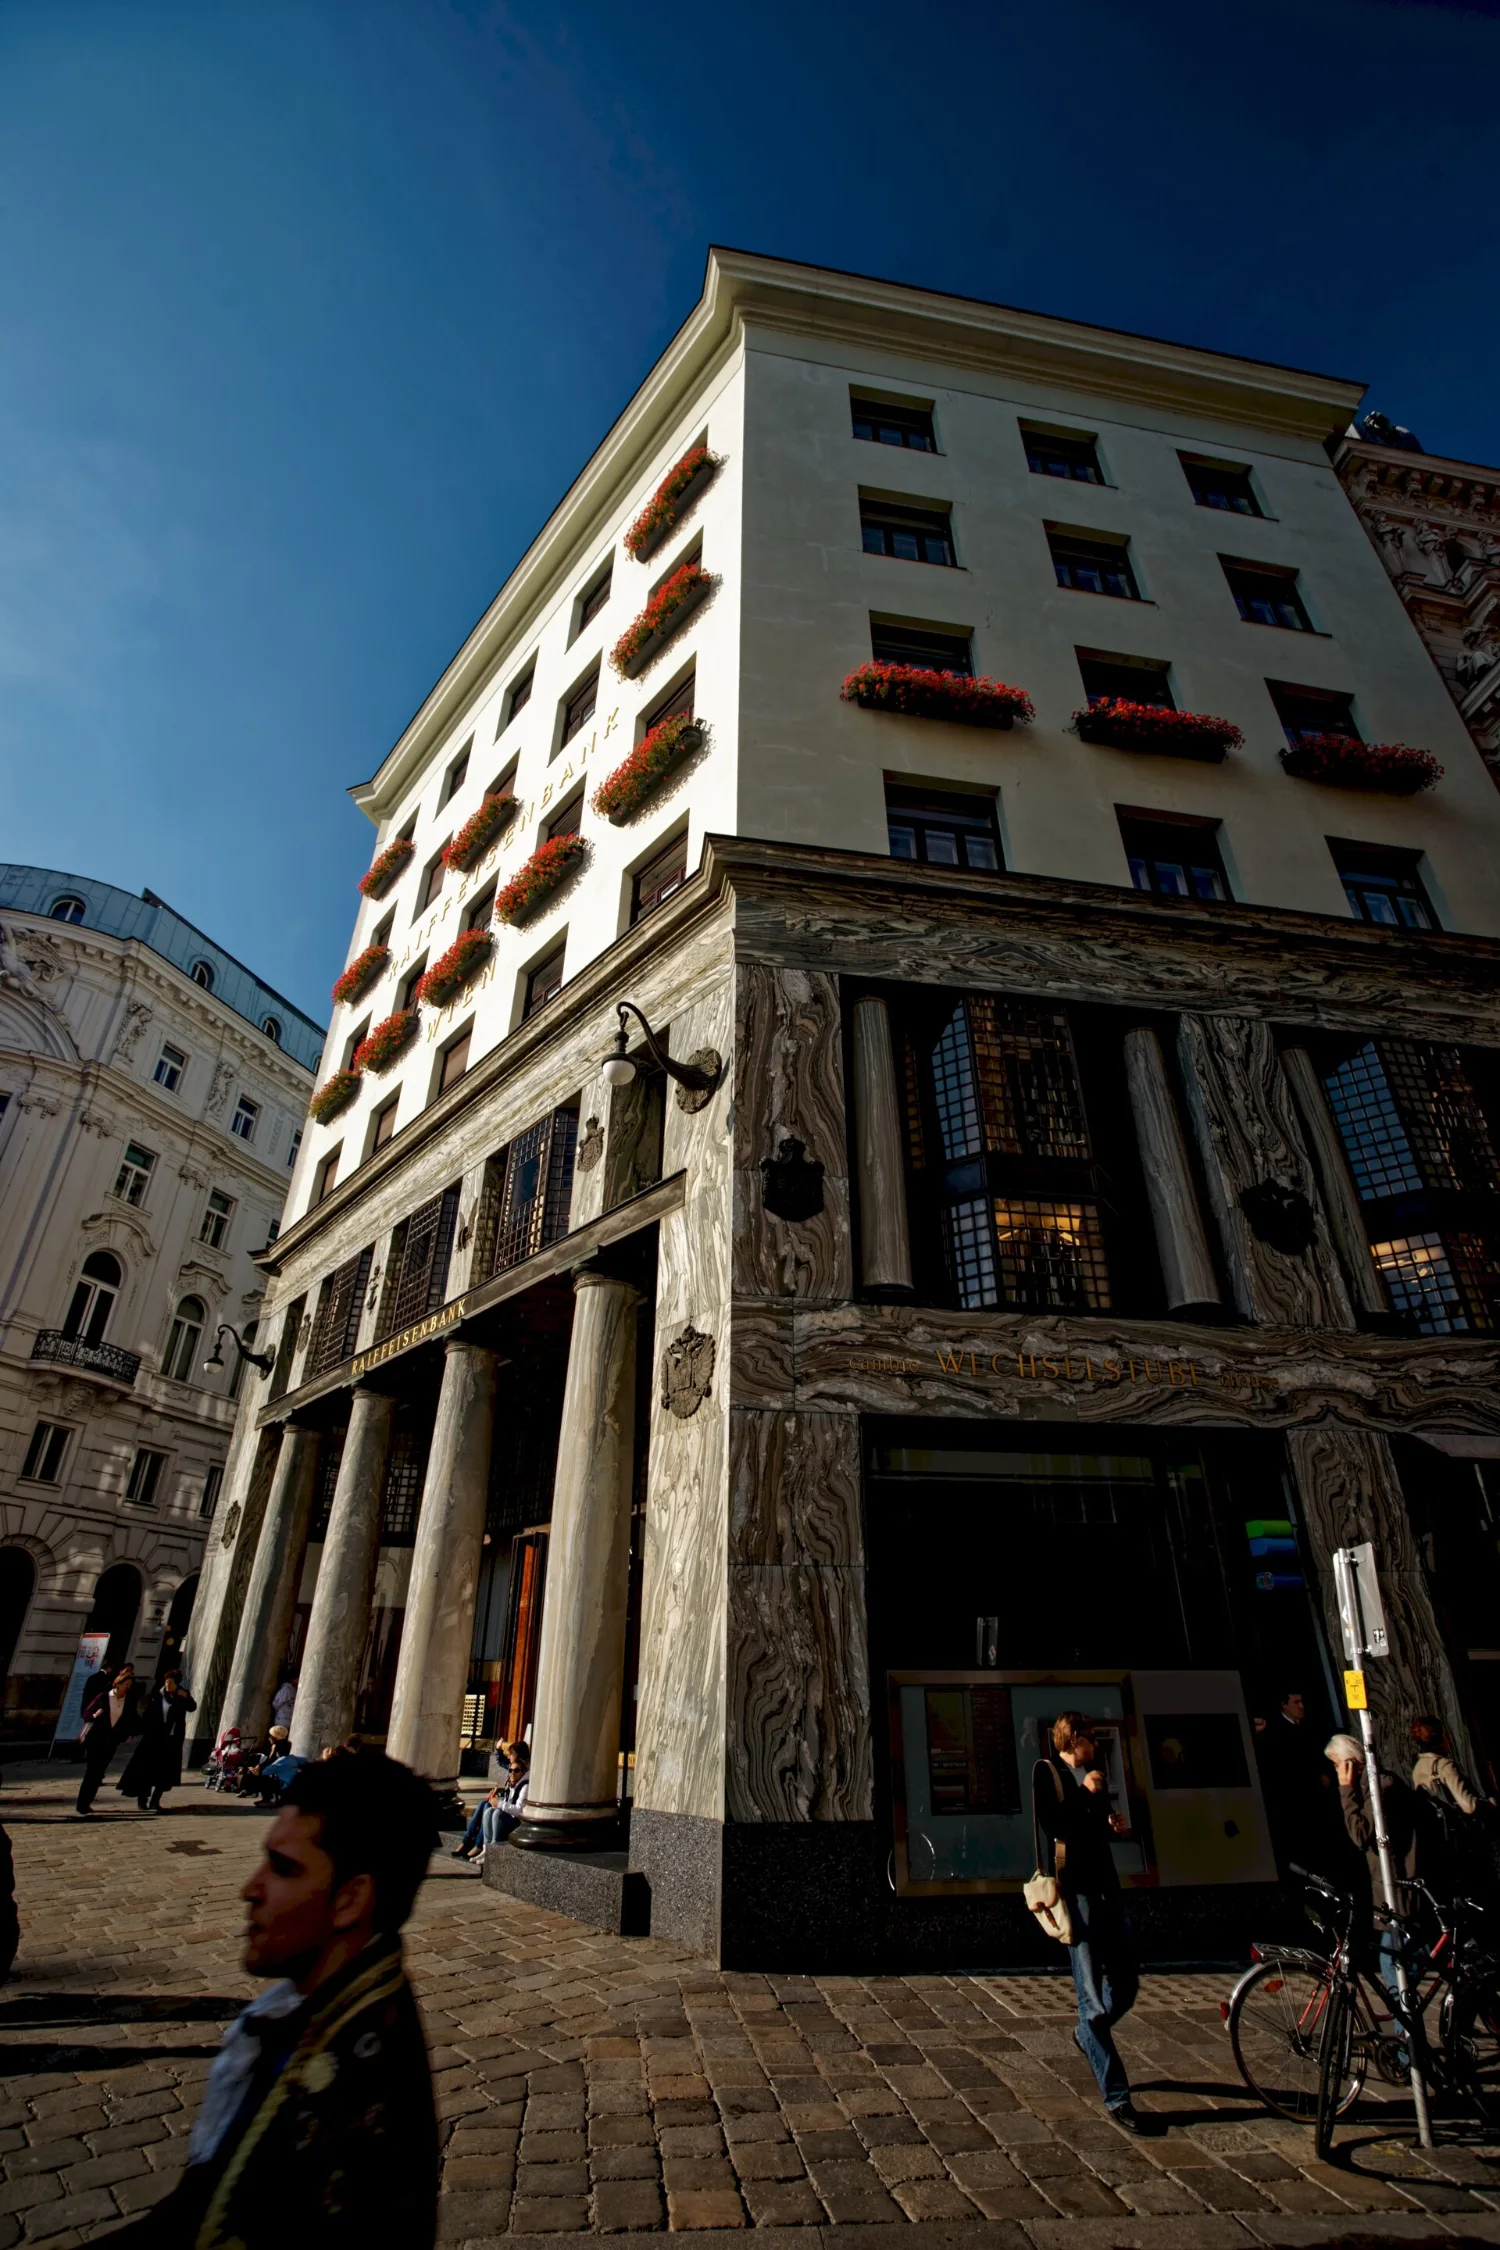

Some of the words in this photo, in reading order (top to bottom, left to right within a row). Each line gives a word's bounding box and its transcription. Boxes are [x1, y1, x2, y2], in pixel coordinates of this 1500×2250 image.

[388, 707, 620, 982] RAIFFEISENBANK
[427, 957, 497, 1043] WIEN
[351, 1299, 466, 1375] RAIFFEISENBANK
[935, 1349, 1207, 1387] WECHSELSTUBE
